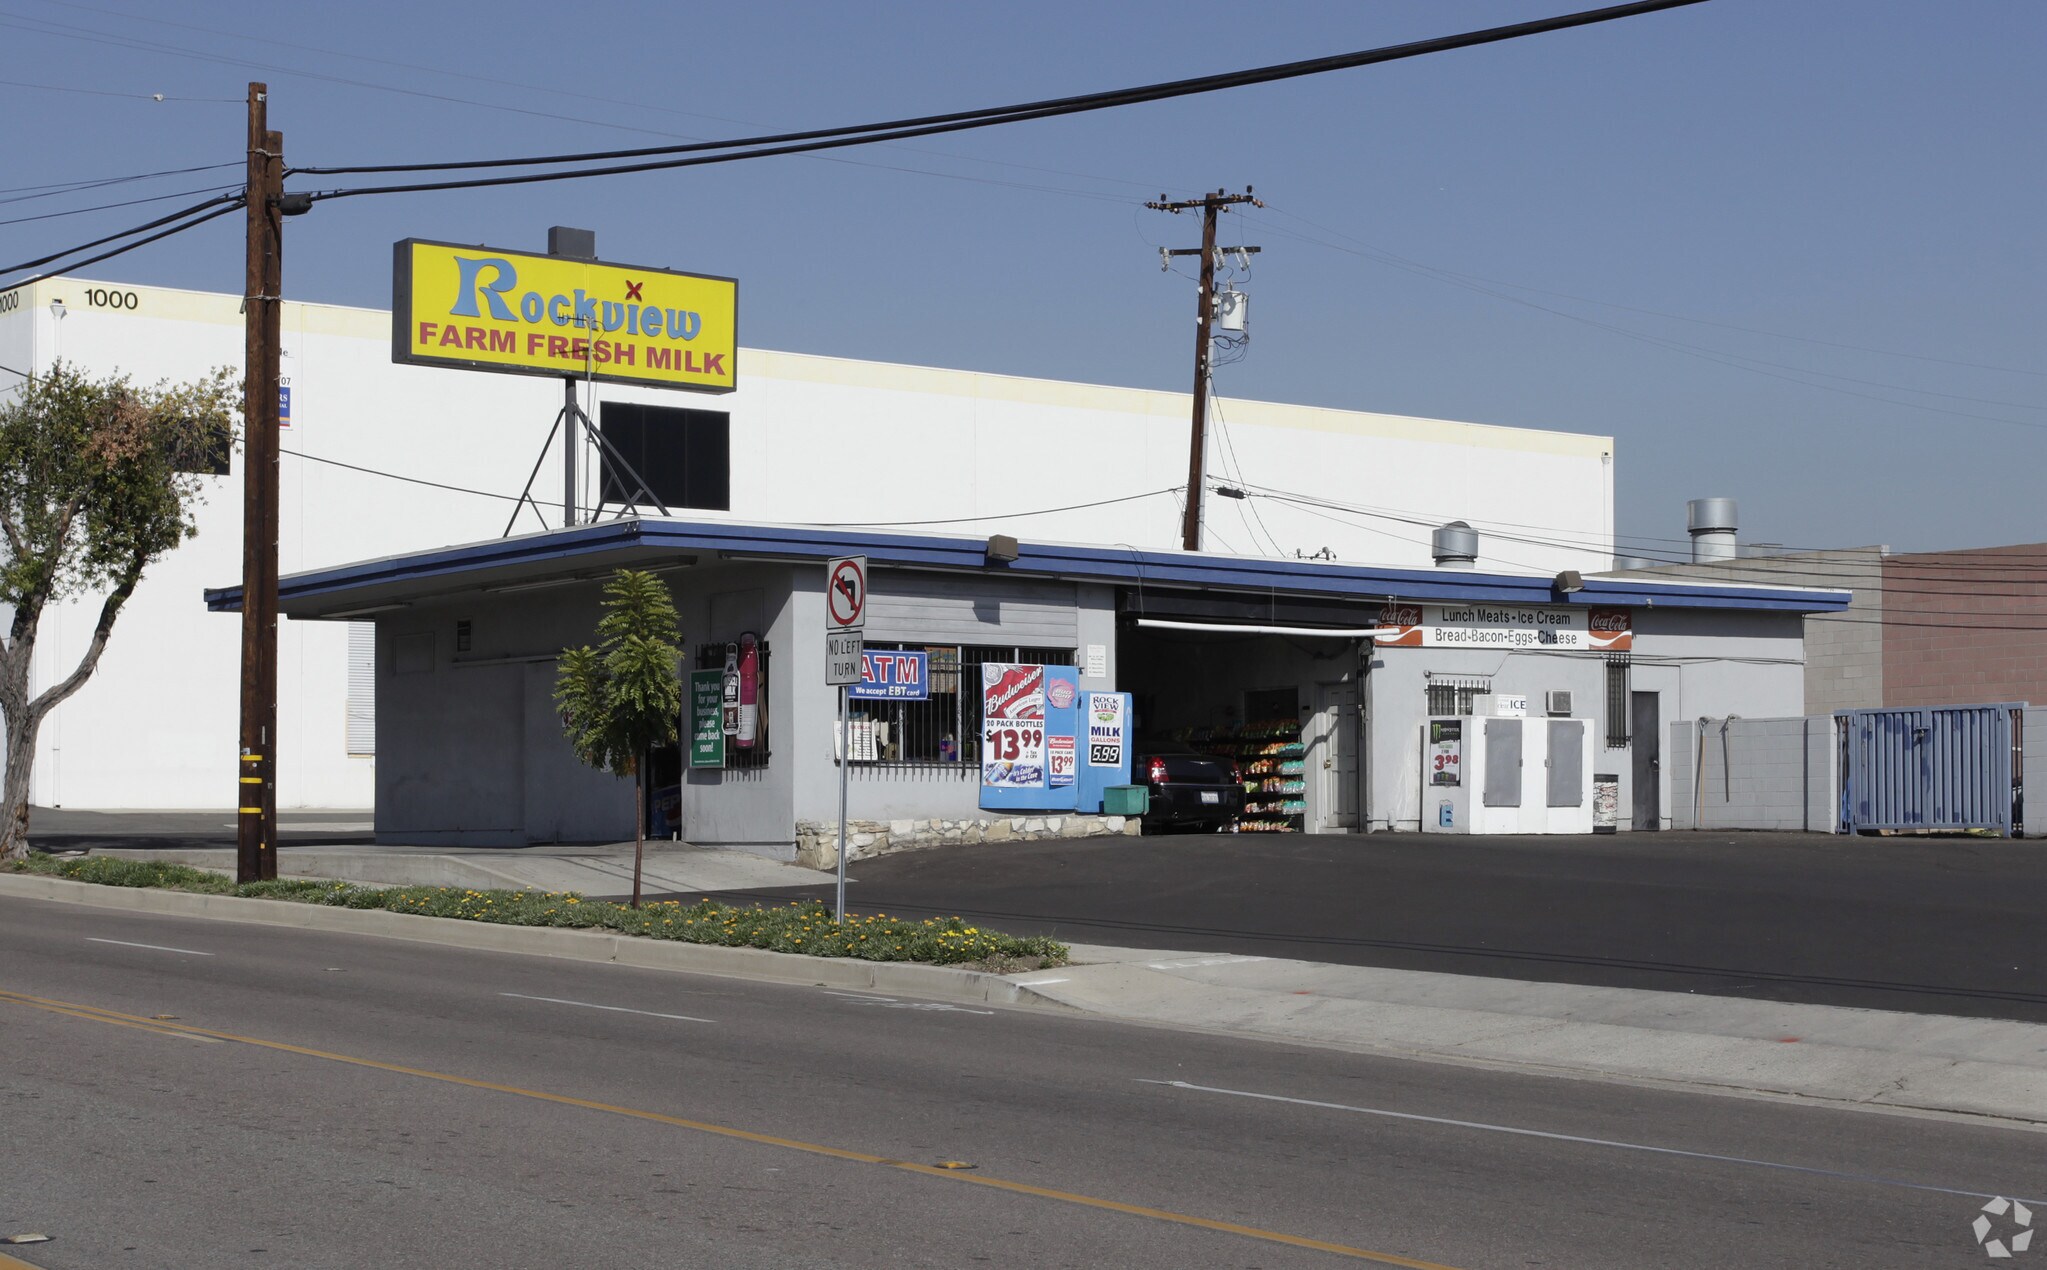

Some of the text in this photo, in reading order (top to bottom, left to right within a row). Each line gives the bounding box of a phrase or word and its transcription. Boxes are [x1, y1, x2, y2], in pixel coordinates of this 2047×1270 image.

[84, 289, 138, 310] 1000
[450, 256, 701, 341] Rockview
[419, 322, 726, 376] FARM FRESH MILK
[1442, 608, 1571, 625] Lunch Meats Ice Cream
[828, 639, 861, 656] NO LEFT
[833, 662, 856, 676] TURN
[861, 654, 919, 685] ATM
[694, 681, 720, 694] Thank you
[855, 686, 865, 694] We
[866, 687, 886, 696] accept
[888, 685, 907, 696] EBT
[985, 666, 1042, 715] Budweiser
[698, 695, 706, 704] for
[706, 696, 718, 706] your
[1092, 696, 1118, 705] ROCK
[1510, 700, 1526, 710] ICE
[1094, 703, 1119, 711] VIEW
[698, 719, 715, 731] please
[986, 719, 1043, 728] 20 PACK BOTTLES
[694, 730, 720, 741] come back
[1091, 726, 1120, 738] MILK
[699, 742, 714, 753] soon!
[653, 794, 680, 813] PEP
